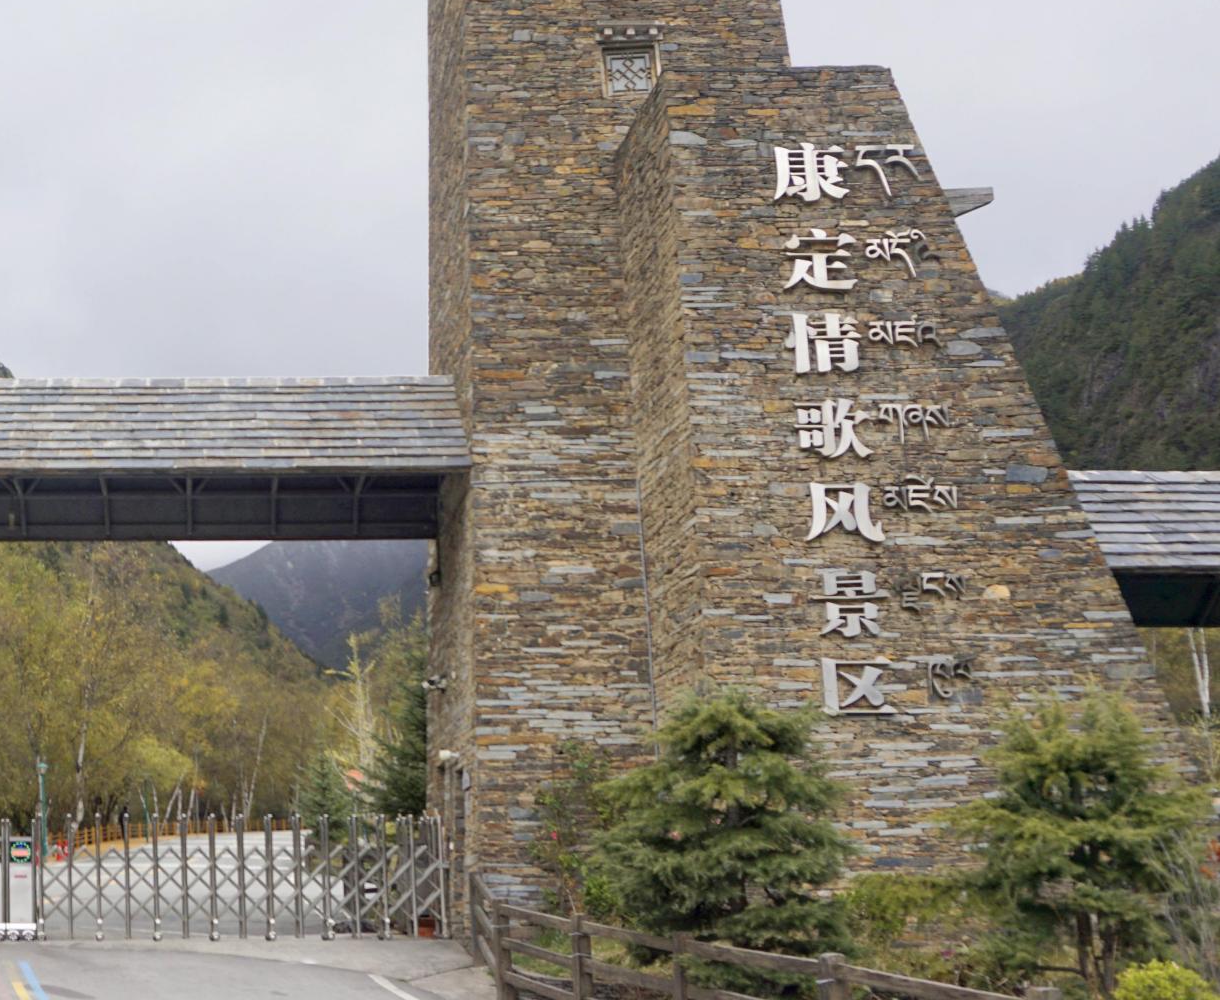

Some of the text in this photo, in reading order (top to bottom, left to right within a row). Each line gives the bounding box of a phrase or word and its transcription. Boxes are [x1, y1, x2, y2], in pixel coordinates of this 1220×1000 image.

[774, 142, 898, 716] 康定情歌风景区
